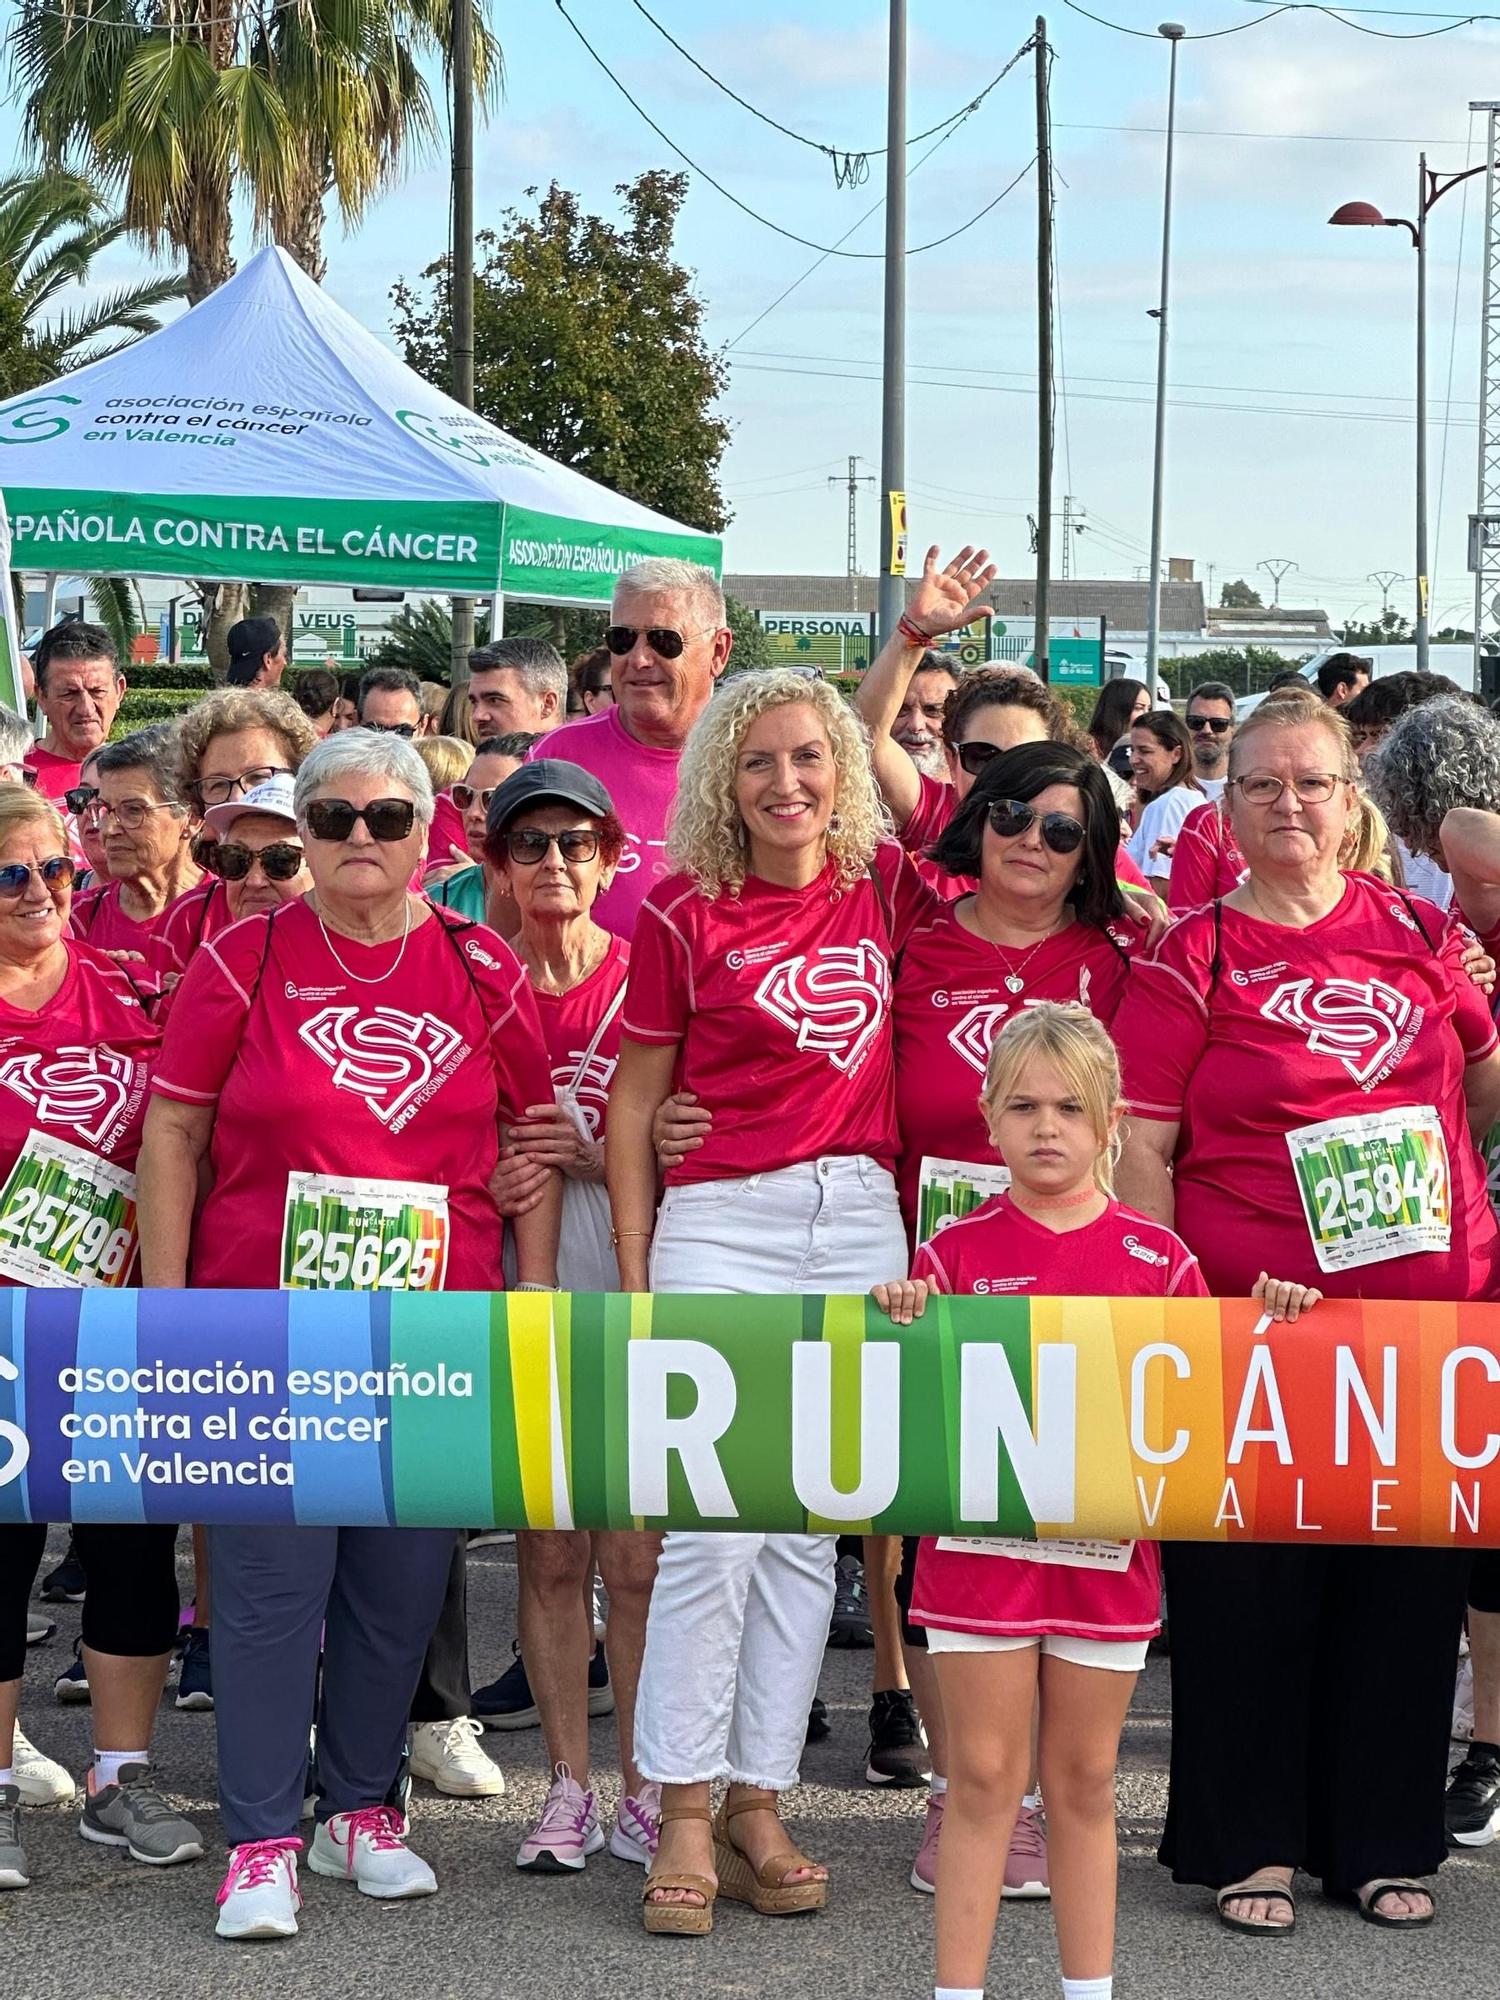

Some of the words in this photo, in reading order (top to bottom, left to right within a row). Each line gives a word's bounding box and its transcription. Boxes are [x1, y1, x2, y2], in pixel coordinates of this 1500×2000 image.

[94, 412, 184, 426] contra
[190, 413, 210, 427] el
[215, 416, 310, 435] cáncer
[104, 394, 245, 413] asociación
[251, 402, 374, 428] española
[83, 430, 117, 442] en
[126, 428, 237, 447] Valencia
[153, 519, 289, 552] CONTRA
[297, 527, 335, 555] EL
[342, 525, 478, 563] CÁNCER
[509, 538, 572, 569] ASOCIACIÓN
[572, 541, 623, 574] ESPAÑOLA
[299, 613, 355, 628] VEUS
[765, 620, 865, 636] PERSONA
[1361, 1066, 1392, 1094] SÚPER
[1386, 1034, 1416, 1069] PERSONA
[100, 1122, 127, 1154] SÚPER
[120, 1089, 145, 1124] PERSONA
[389, 1104, 419, 1135] SÚPER
[413, 1071, 449, 1107] PERSONA
[1315, 1160, 1445, 1230] 25842
[0, 1187, 132, 1275] 25796
[292, 1229, 441, 1288] 25625
[58, 1360, 275, 1395] asociación
[287, 1362, 473, 1404] española
[60, 1407, 192, 1440] contra
[202, 1407, 237, 1441] el
[248, 1408, 389, 1442] cáncer
[628, 1339, 1077, 1523] RUN
[1130, 1313, 1500, 1469] CÁNC
[61, 1457, 111, 1483] en
[120, 1452, 294, 1486] Valencia
[1136, 1476, 1480, 1534] VALEN
